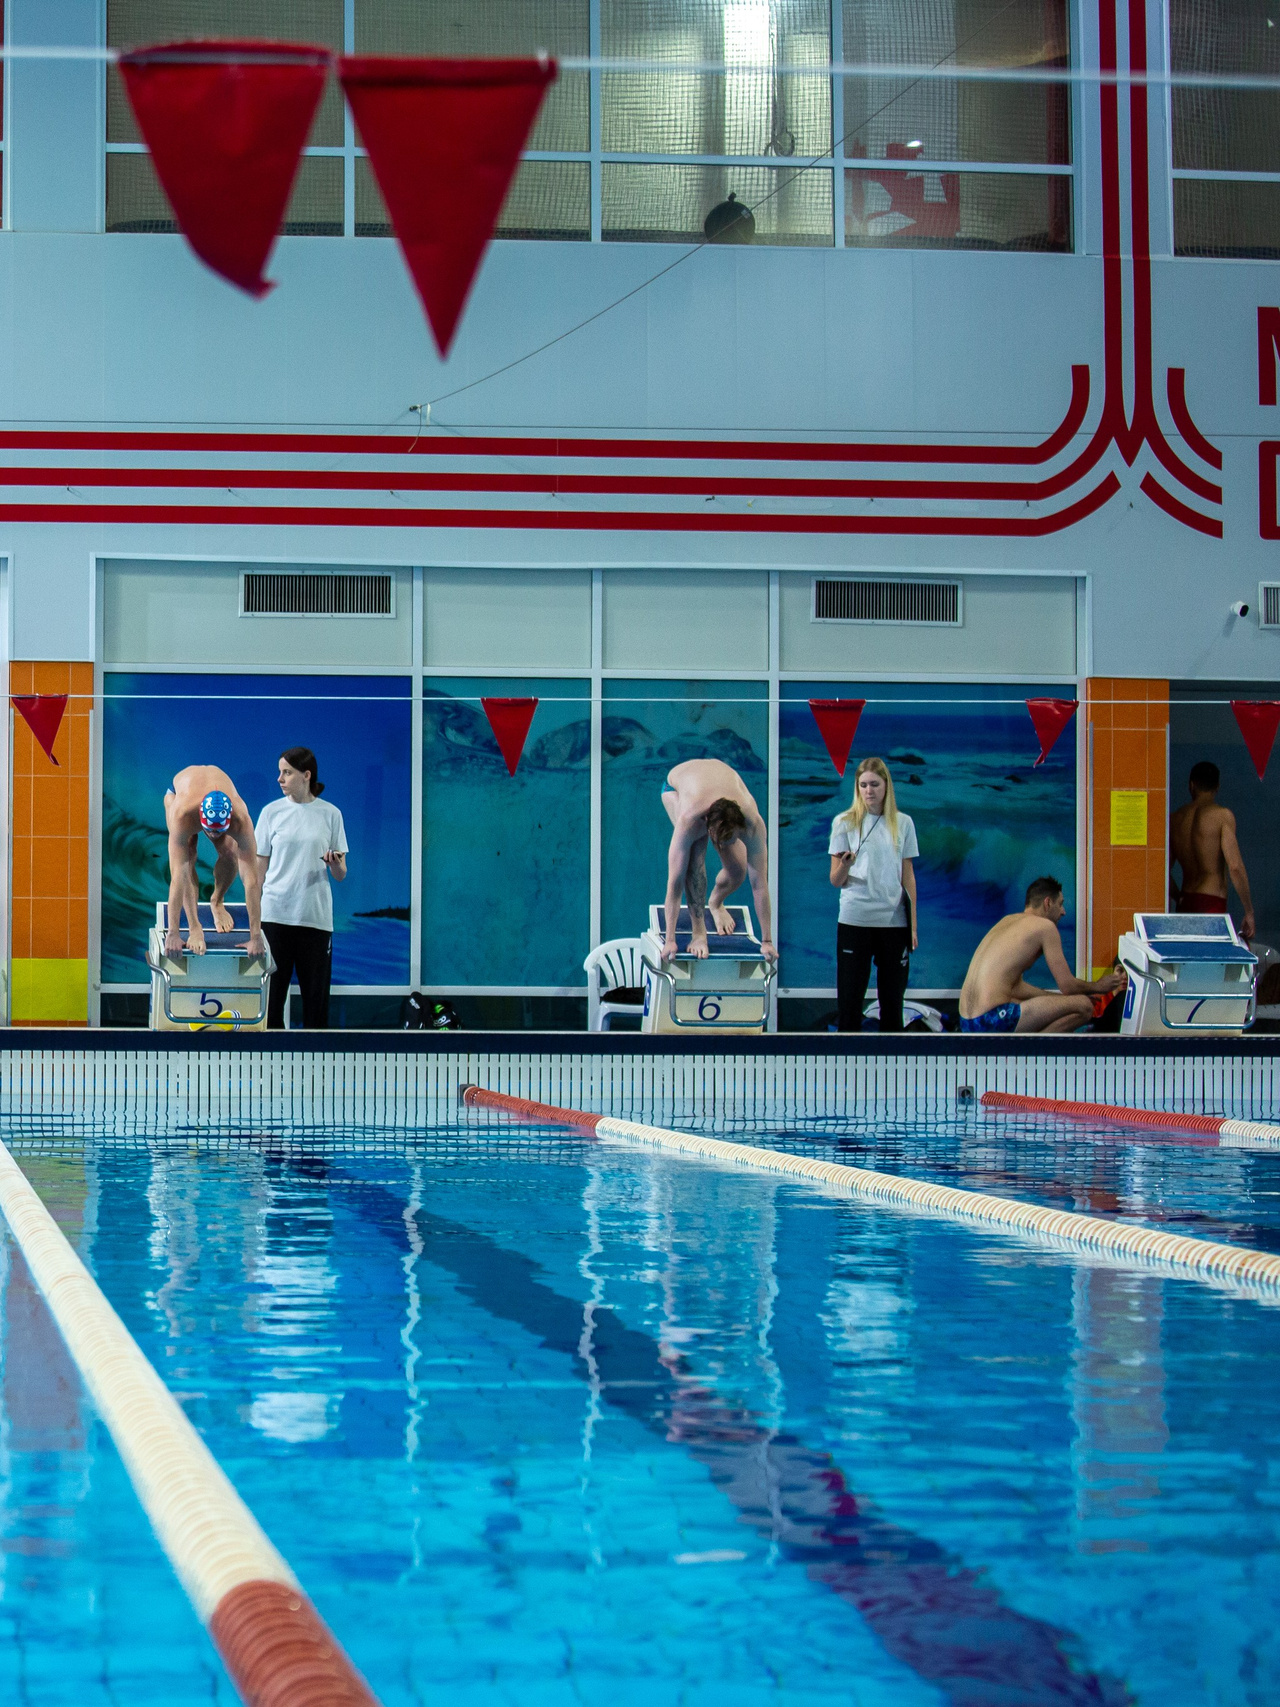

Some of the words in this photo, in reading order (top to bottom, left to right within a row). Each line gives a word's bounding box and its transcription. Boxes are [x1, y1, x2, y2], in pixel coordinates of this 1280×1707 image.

[199, 991, 223, 1018] 5
[698, 995, 723, 1021] 6
[1186, 997, 1208, 1023] 7
